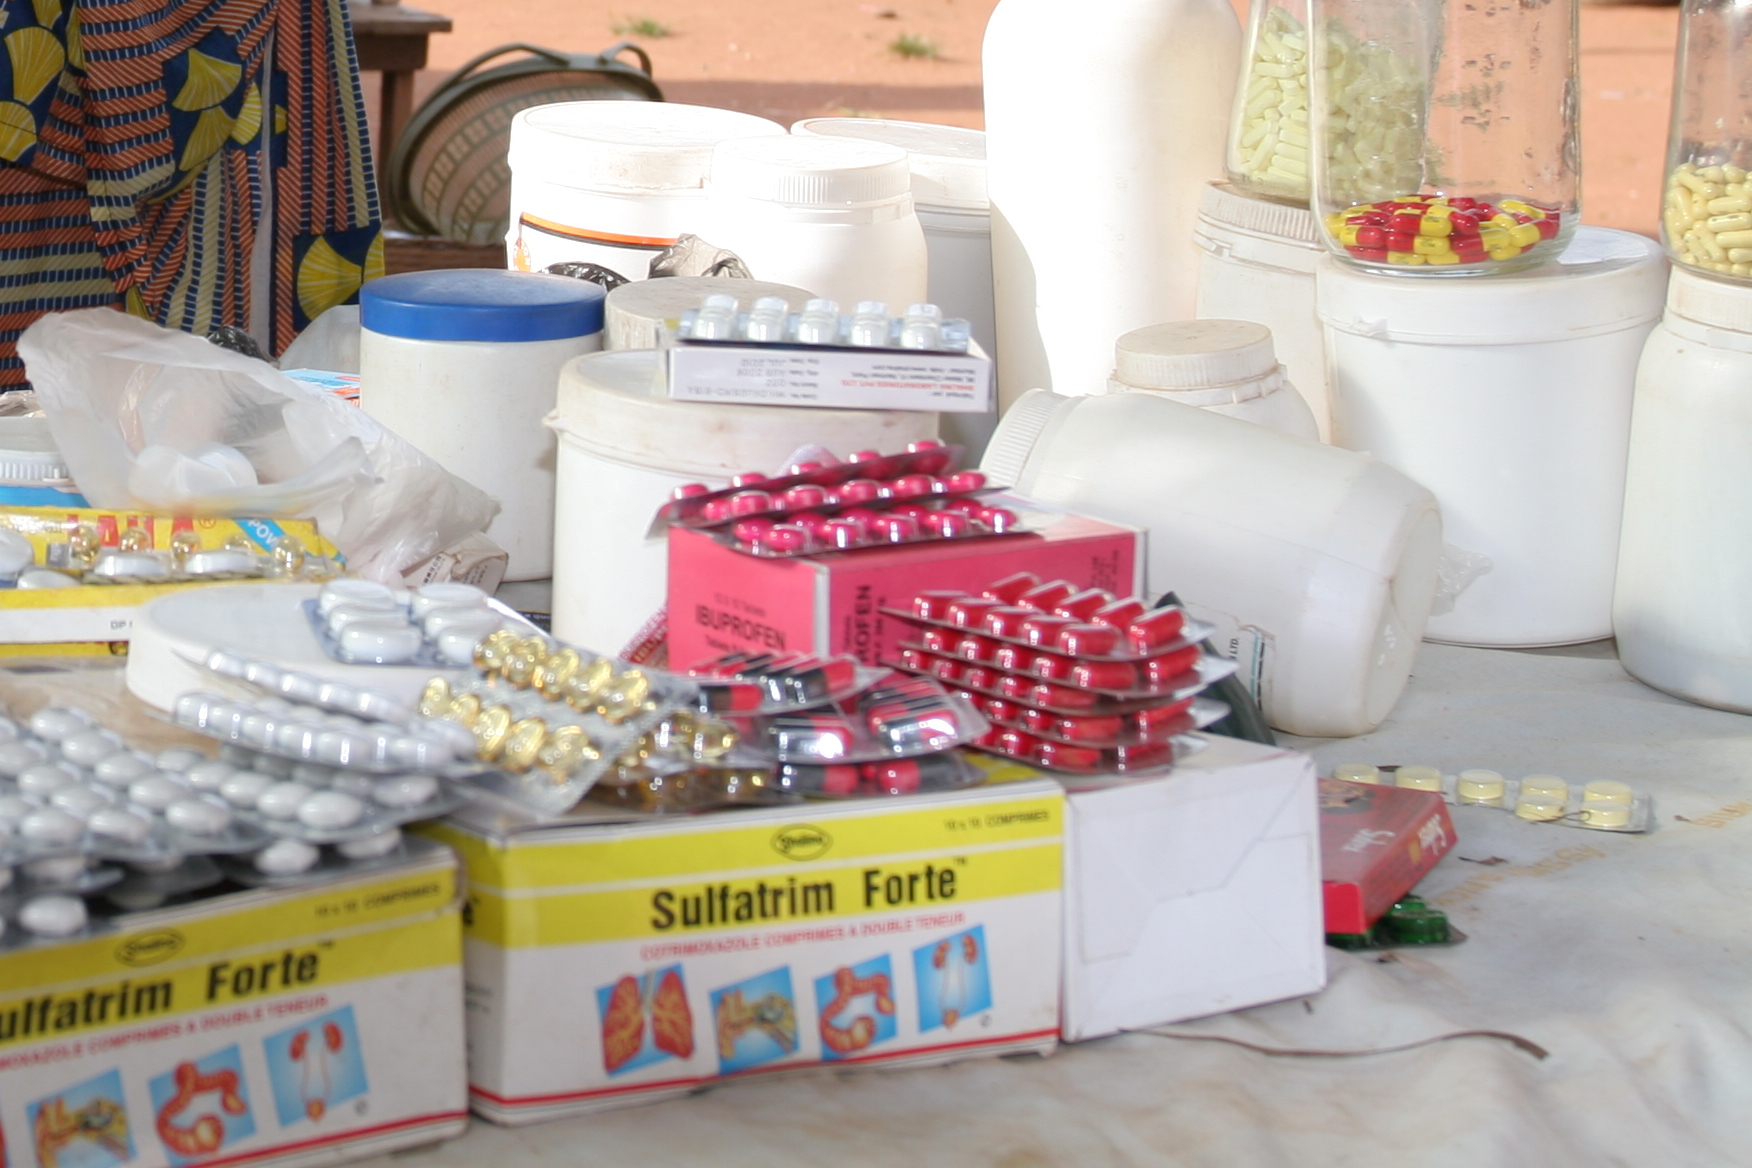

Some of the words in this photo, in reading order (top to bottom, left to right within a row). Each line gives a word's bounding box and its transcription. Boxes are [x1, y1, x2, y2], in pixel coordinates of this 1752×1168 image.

[695, 603, 786, 650] IBUPROFEN
[651, 877, 835, 932] Sulfatrim
[862, 863, 958, 909] Forte
[206, 951, 321, 1002] Forte
